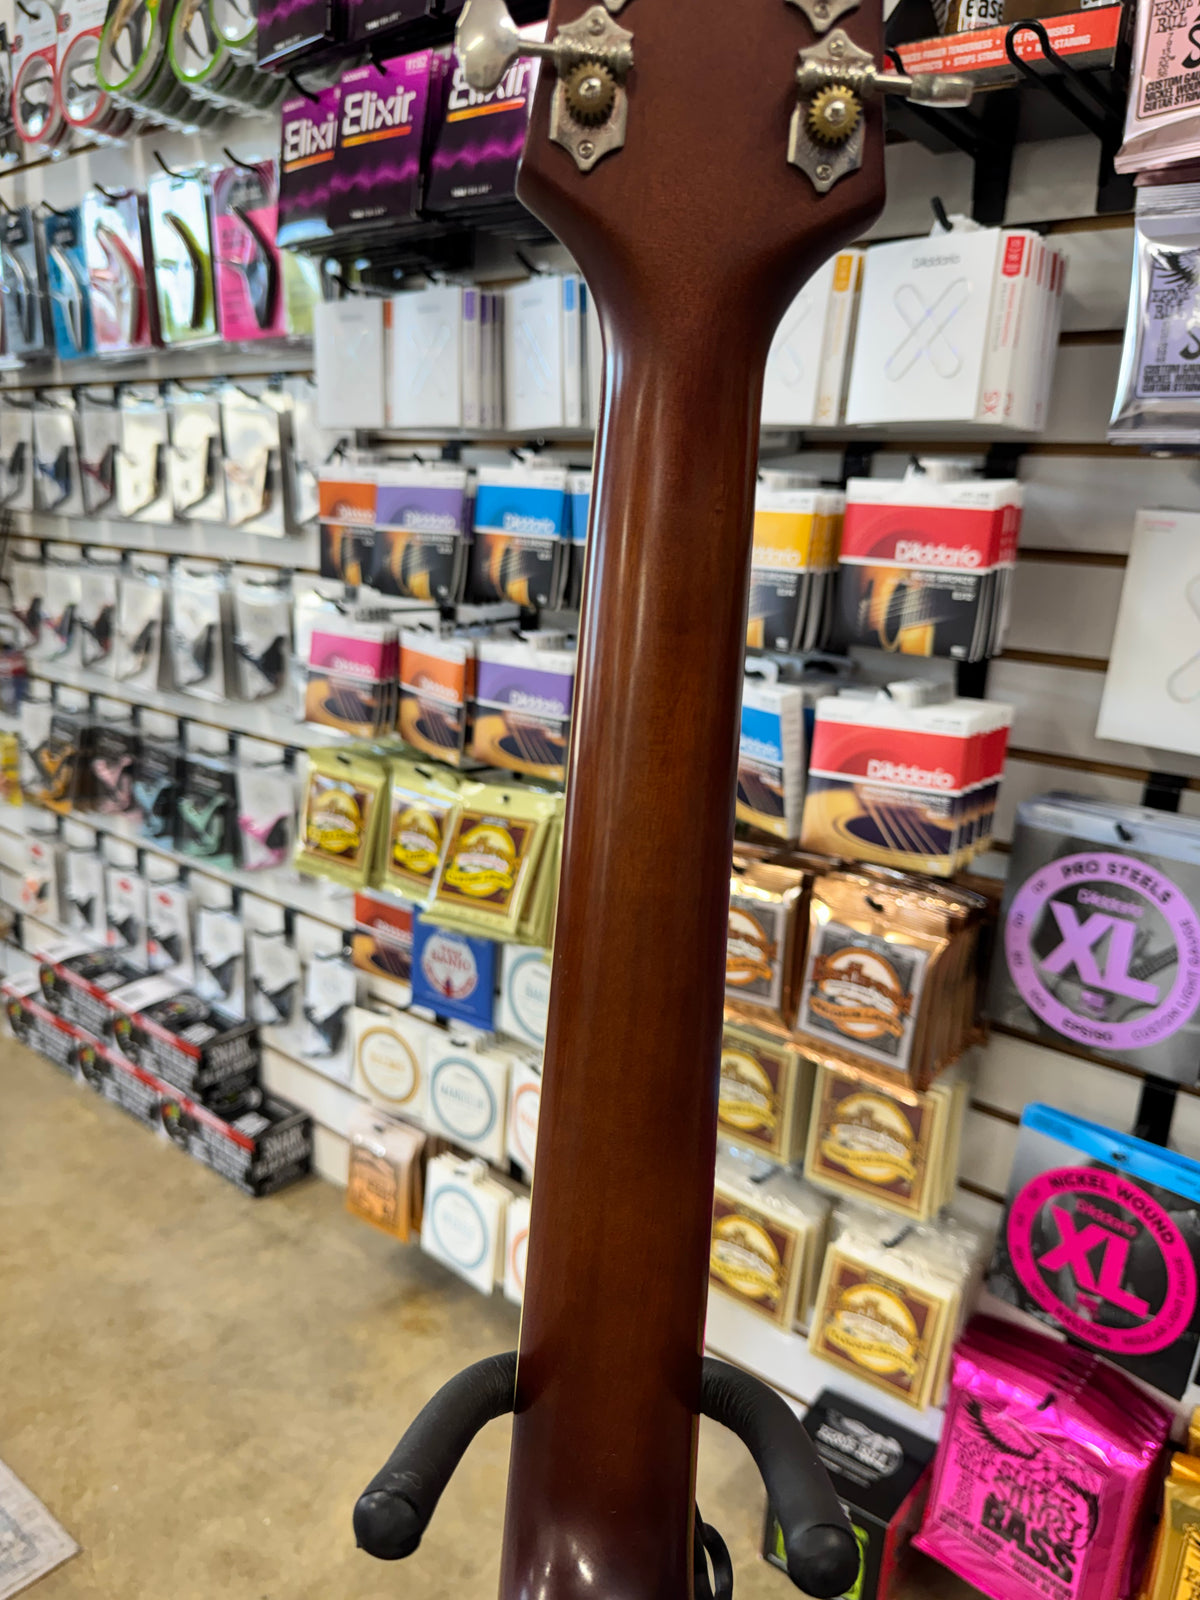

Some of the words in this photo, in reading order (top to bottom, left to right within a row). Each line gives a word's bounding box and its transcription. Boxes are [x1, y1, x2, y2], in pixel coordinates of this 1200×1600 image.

[1145, 75, 1183, 93] CUSTOM
[1183, 71, 1200, 84] GAU
[1173, 91, 1200, 106] STRIN
[1176, 81, 1200, 96] WOUN
[341, 85, 416, 136] Elixir
[1061, 860, 1099, 879] PRO
[1106, 862, 1173, 905] STEELS
[1041, 899, 1160, 1006] XL
[1048, 1172, 1111, 1192] NICKEL
[1115, 1184, 1175, 1245] WOUND
[1037, 1204, 1150, 1318] XL
[981, 1491, 1077, 1584] BASS
